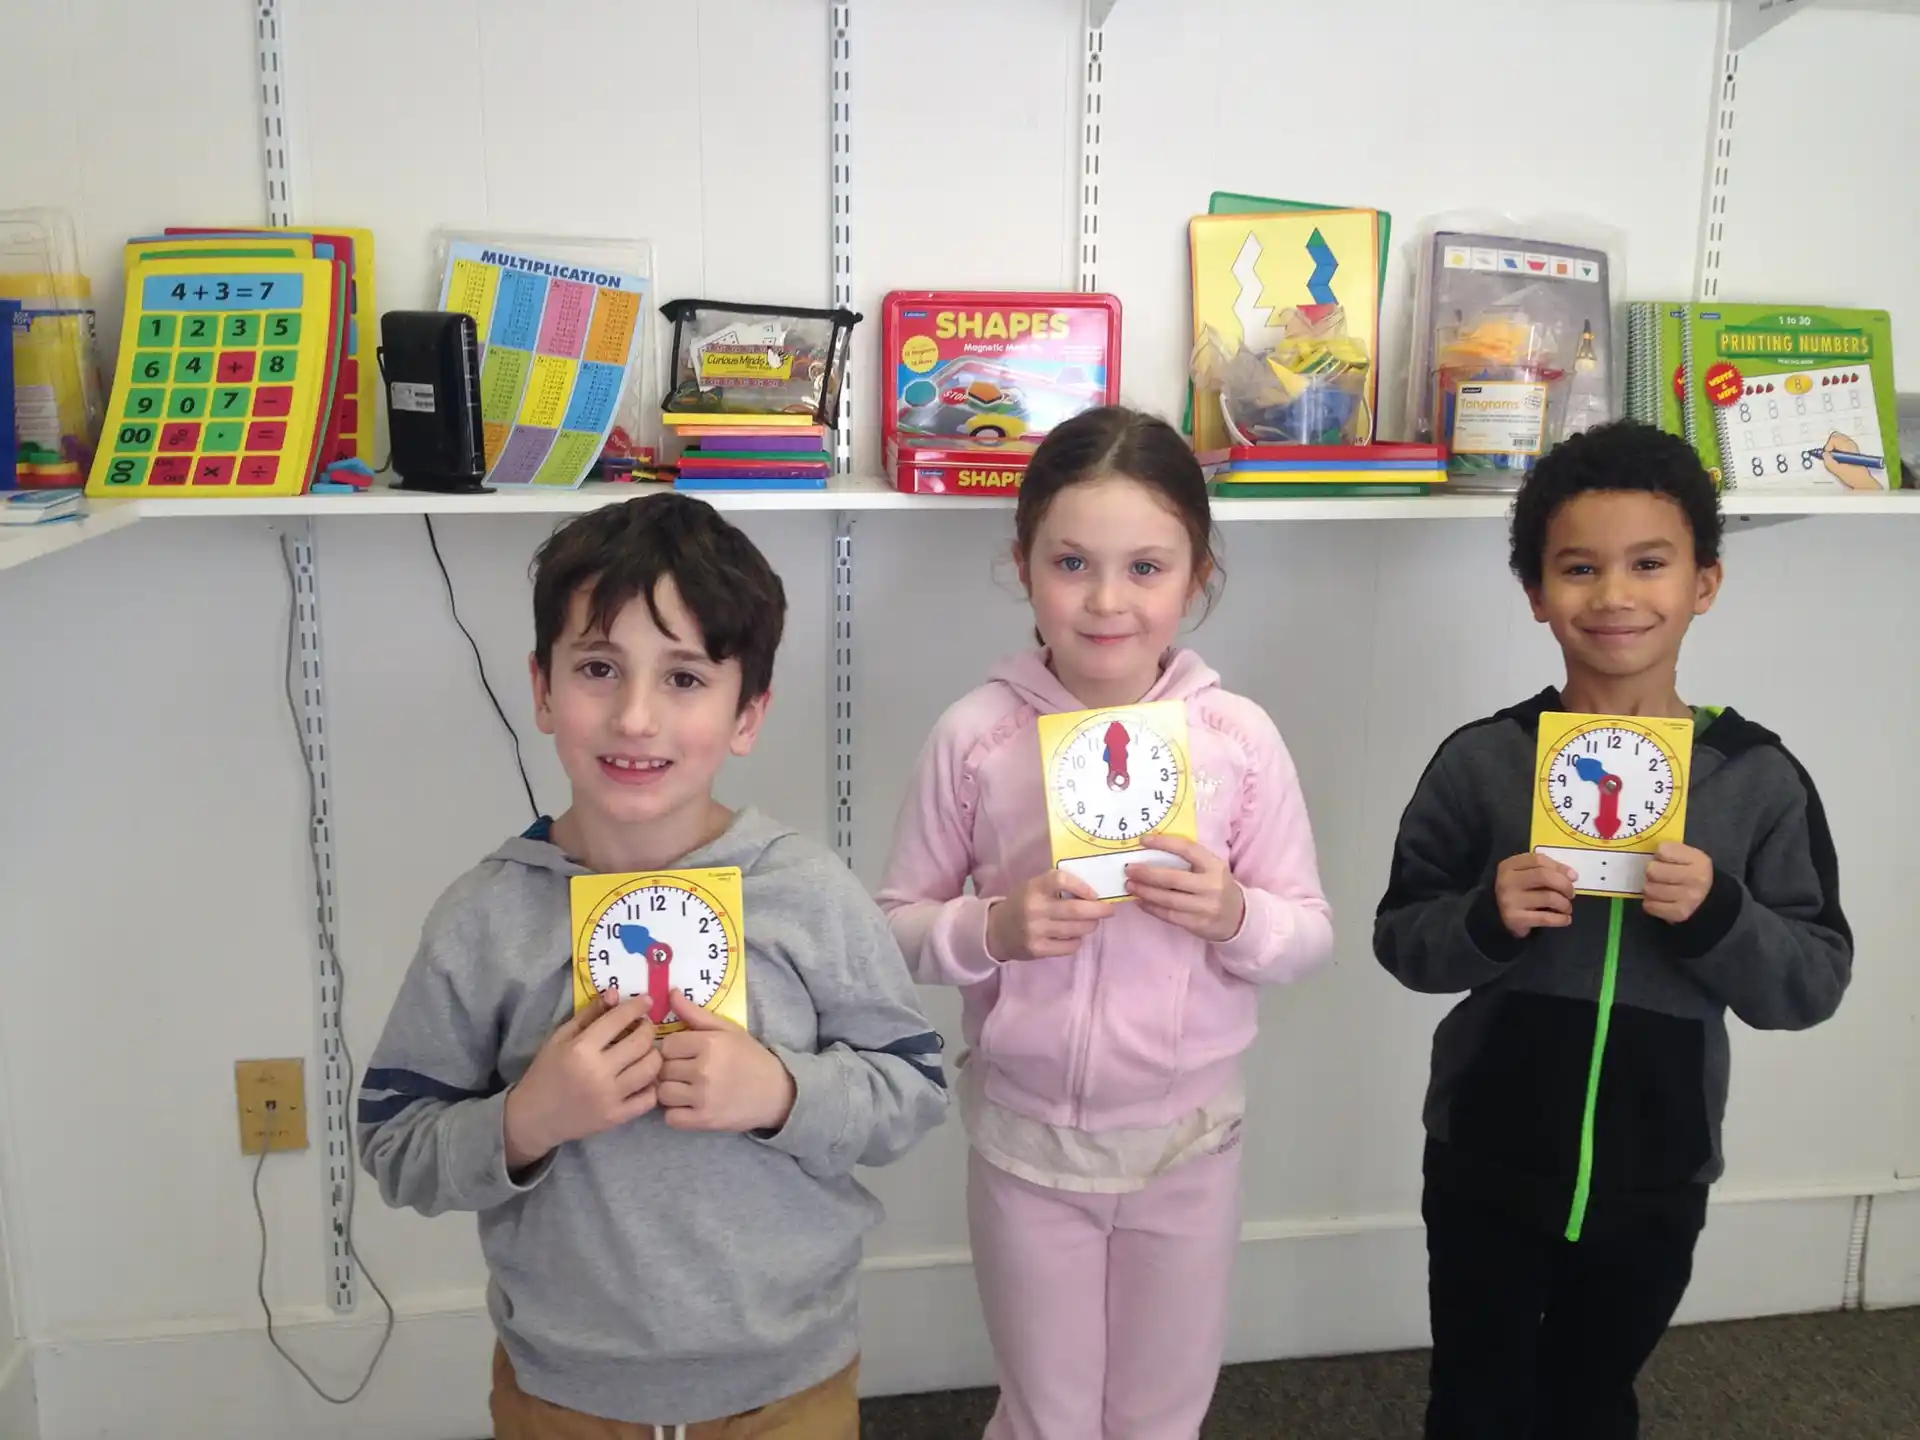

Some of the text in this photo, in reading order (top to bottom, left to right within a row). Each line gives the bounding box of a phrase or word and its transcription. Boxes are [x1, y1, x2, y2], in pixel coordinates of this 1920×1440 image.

[480, 250, 621, 288] MULTIPLICATION
[171, 282, 186, 301] 4
[215, 282, 229, 300] 3
[260, 282, 274, 300] 7
[152, 318, 288, 337] 1 2 3 5
[935, 311, 1070, 340] SHAPES
[1778, 316, 1811, 326] 1 to 30
[963, 343, 1004, 353] Magnetic
[1721, 334, 1869, 353] PRINTING NUMBERS
[707, 354, 766, 364] Curious Minds
[144, 361, 160, 378] 6
[185, 357, 201, 374] 4
[269, 356, 284, 372] 8
[1708, 370, 1734, 387] WRITE
[1717, 385, 1738, 400] WIPE
[137, 397, 152, 413] 9
[180, 397, 195, 413] 0
[224, 392, 238, 409] 7
[1460, 397, 1520, 412] Tangrams
[1740, 403, 1751, 423] 8
[120, 428, 151, 443] 00
[1752, 450, 1813, 476] 8 8 8
[958, 469, 1024, 488] SHAPE
[1586, 740, 1598, 753] 11
[1607, 736, 1621, 749] 12
[1634, 743, 1639, 755] 1
[1150, 746, 1160, 760] 2
[1072, 755, 1086, 769] 10
[1649, 758, 1658, 771] 2
[1160, 768, 1169, 781] 3
[1557, 774, 1567, 787] 9
[1066, 779, 1076, 793] 9
[1654, 781, 1664, 793] 3
[1154, 790, 1164, 804] 4
[1563, 796, 1572, 808] 8
[1077, 801, 1085, 814] 8
[1645, 800, 1655, 814] 4
[1095, 814, 1104, 828] 7
[1141, 808, 1150, 821] 5
[1581, 812, 1590, 825] 7
[1627, 814, 1637, 827] 5
[1118, 817, 1127, 831] 6
[650, 895, 667, 911] 12
[682, 901, 687, 916] 1
[627, 904, 640, 920] 11
[607, 923, 622, 939] 10
[698, 917, 709, 933] 2
[598, 950, 609, 965] 9
[708, 944, 719, 959] 3
[609, 976, 619, 989] 8
[700, 969, 711, 985] 4
[684, 988, 694, 1001] 5
